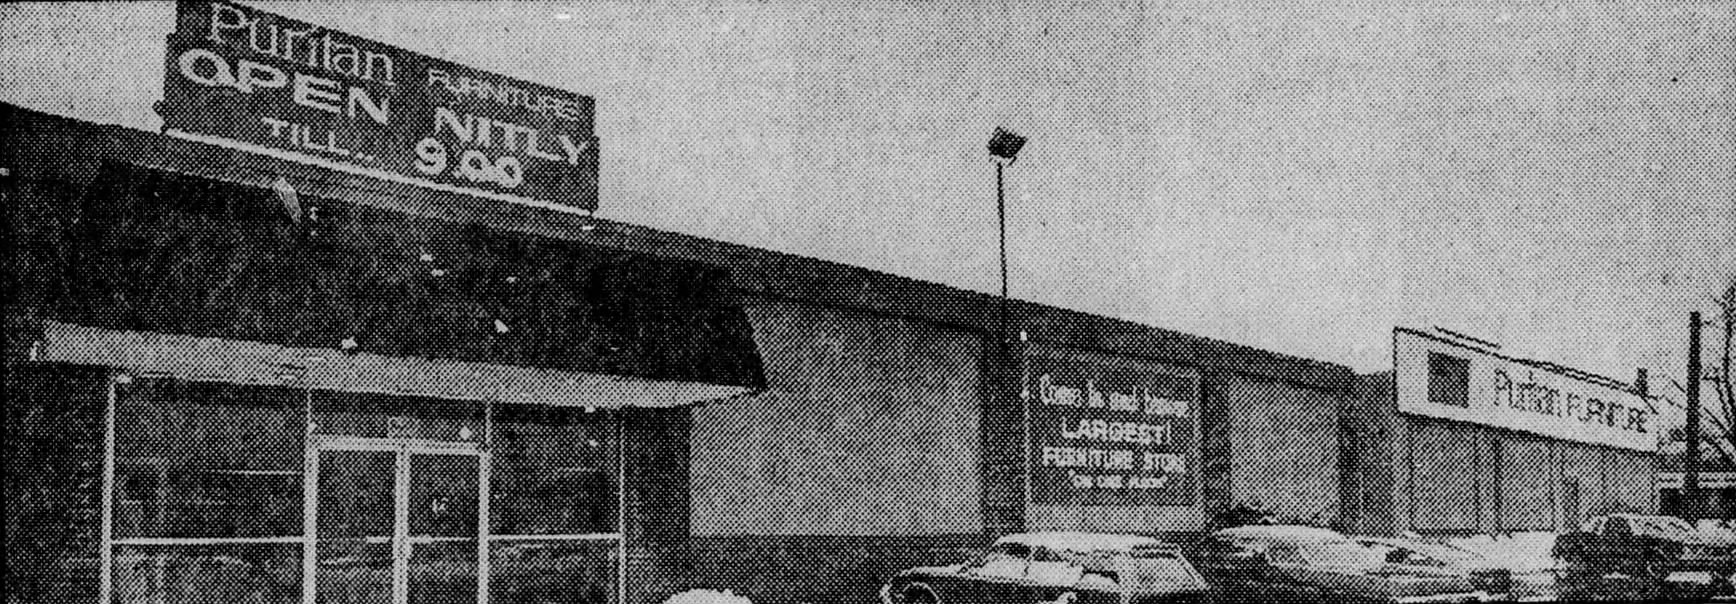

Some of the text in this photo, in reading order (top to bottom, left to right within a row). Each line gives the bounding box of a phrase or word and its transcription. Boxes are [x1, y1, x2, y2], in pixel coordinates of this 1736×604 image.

[179, 48, 589, 166] OPEN NITLY
[211, 3, 580, 121] Puritan FURNITURE
